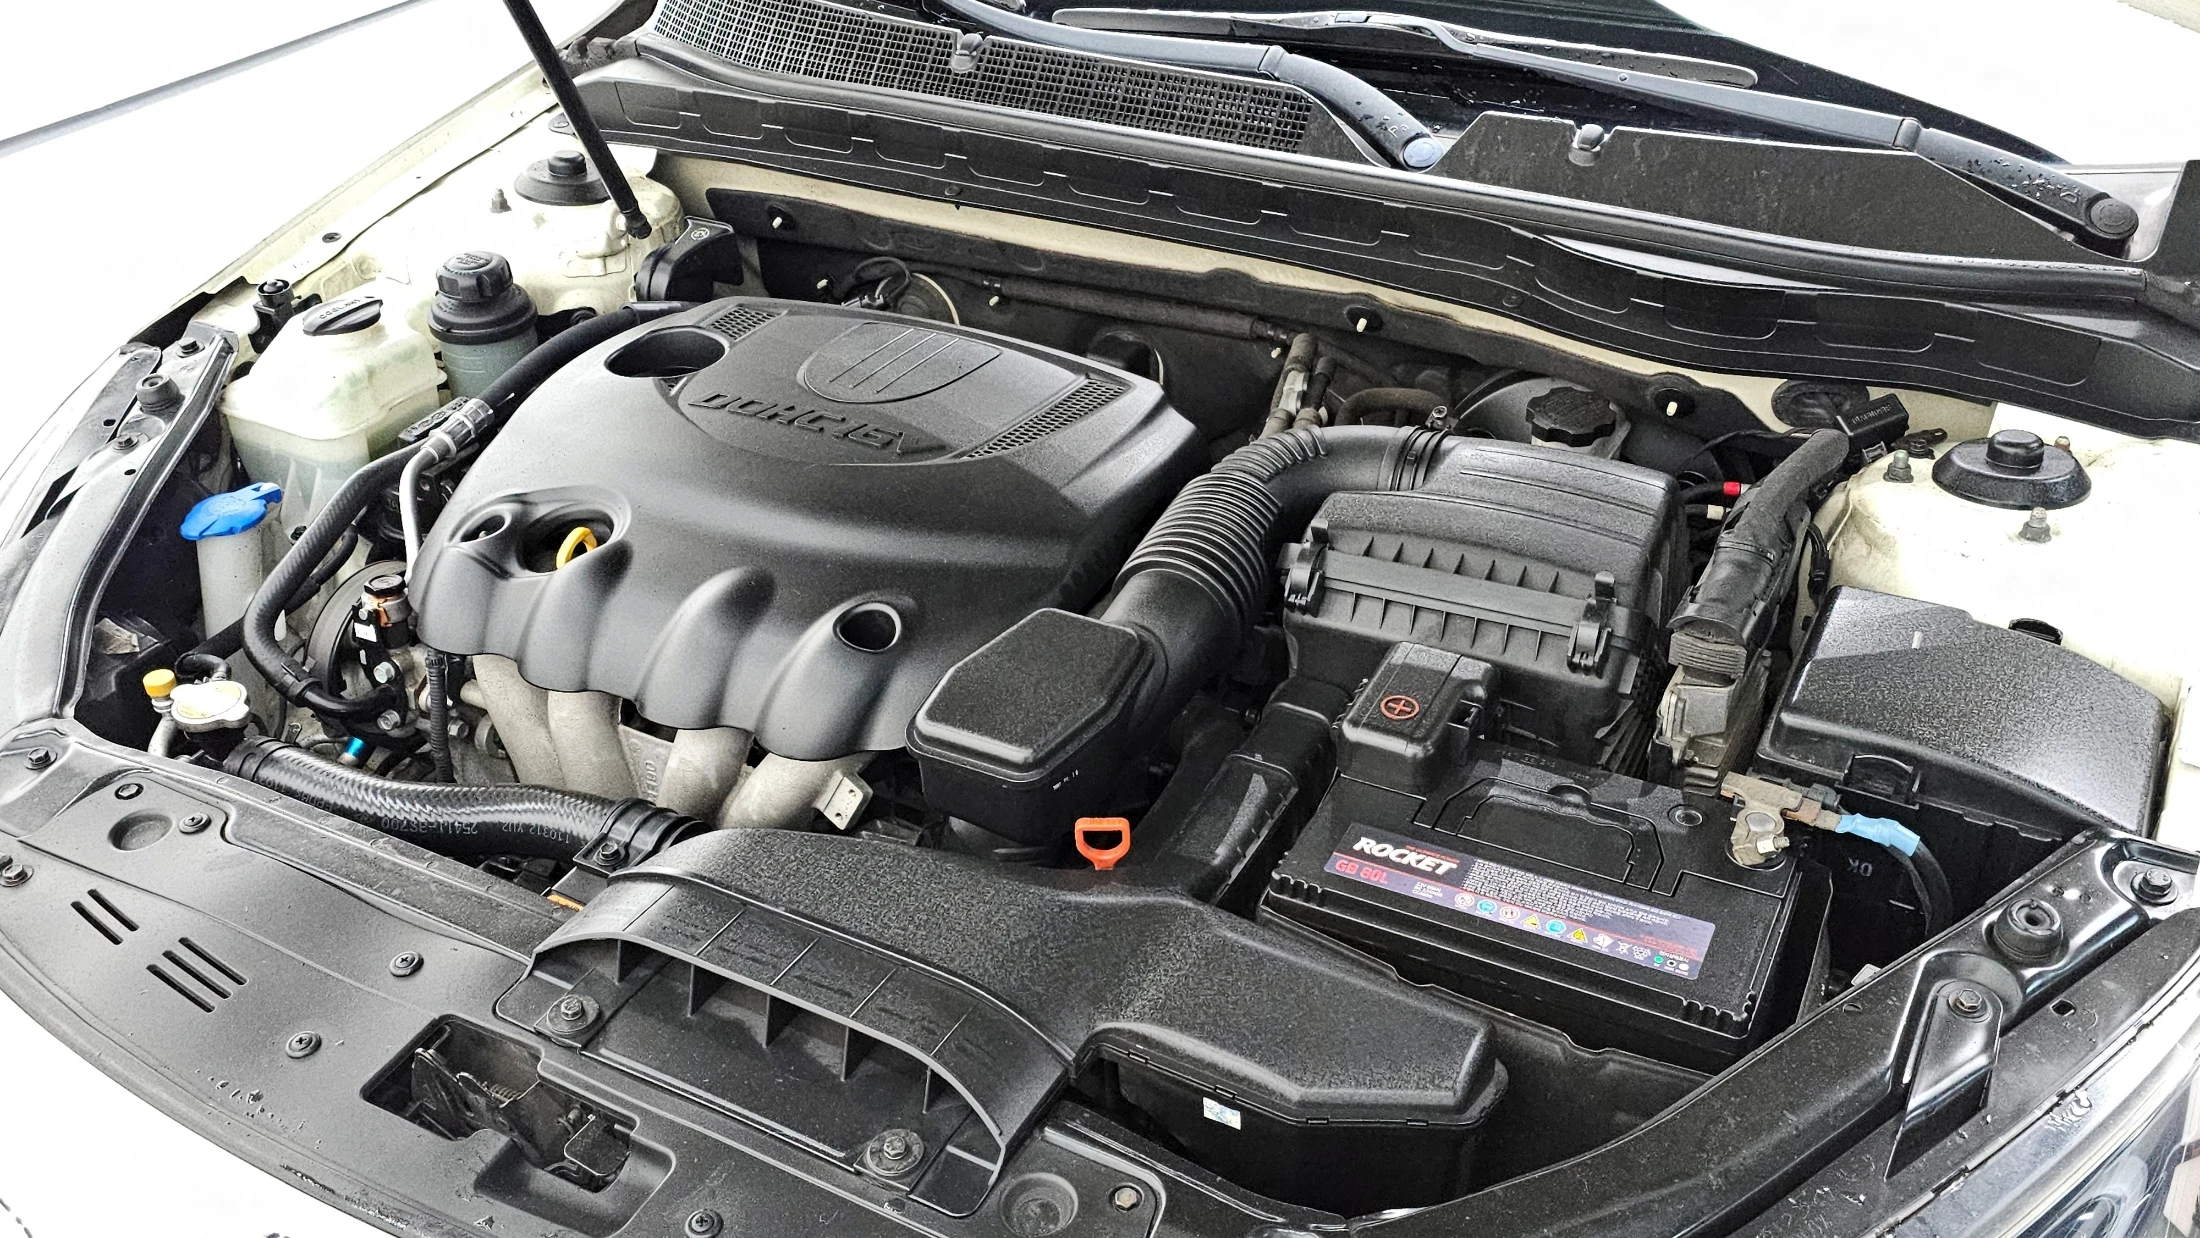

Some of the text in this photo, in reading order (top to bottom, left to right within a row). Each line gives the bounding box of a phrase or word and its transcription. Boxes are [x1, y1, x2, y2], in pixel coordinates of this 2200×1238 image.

[687, 393, 847, 433] DOHC
[1335, 859, 1360, 875] GB
[1352, 836, 1459, 876] ROCKET
